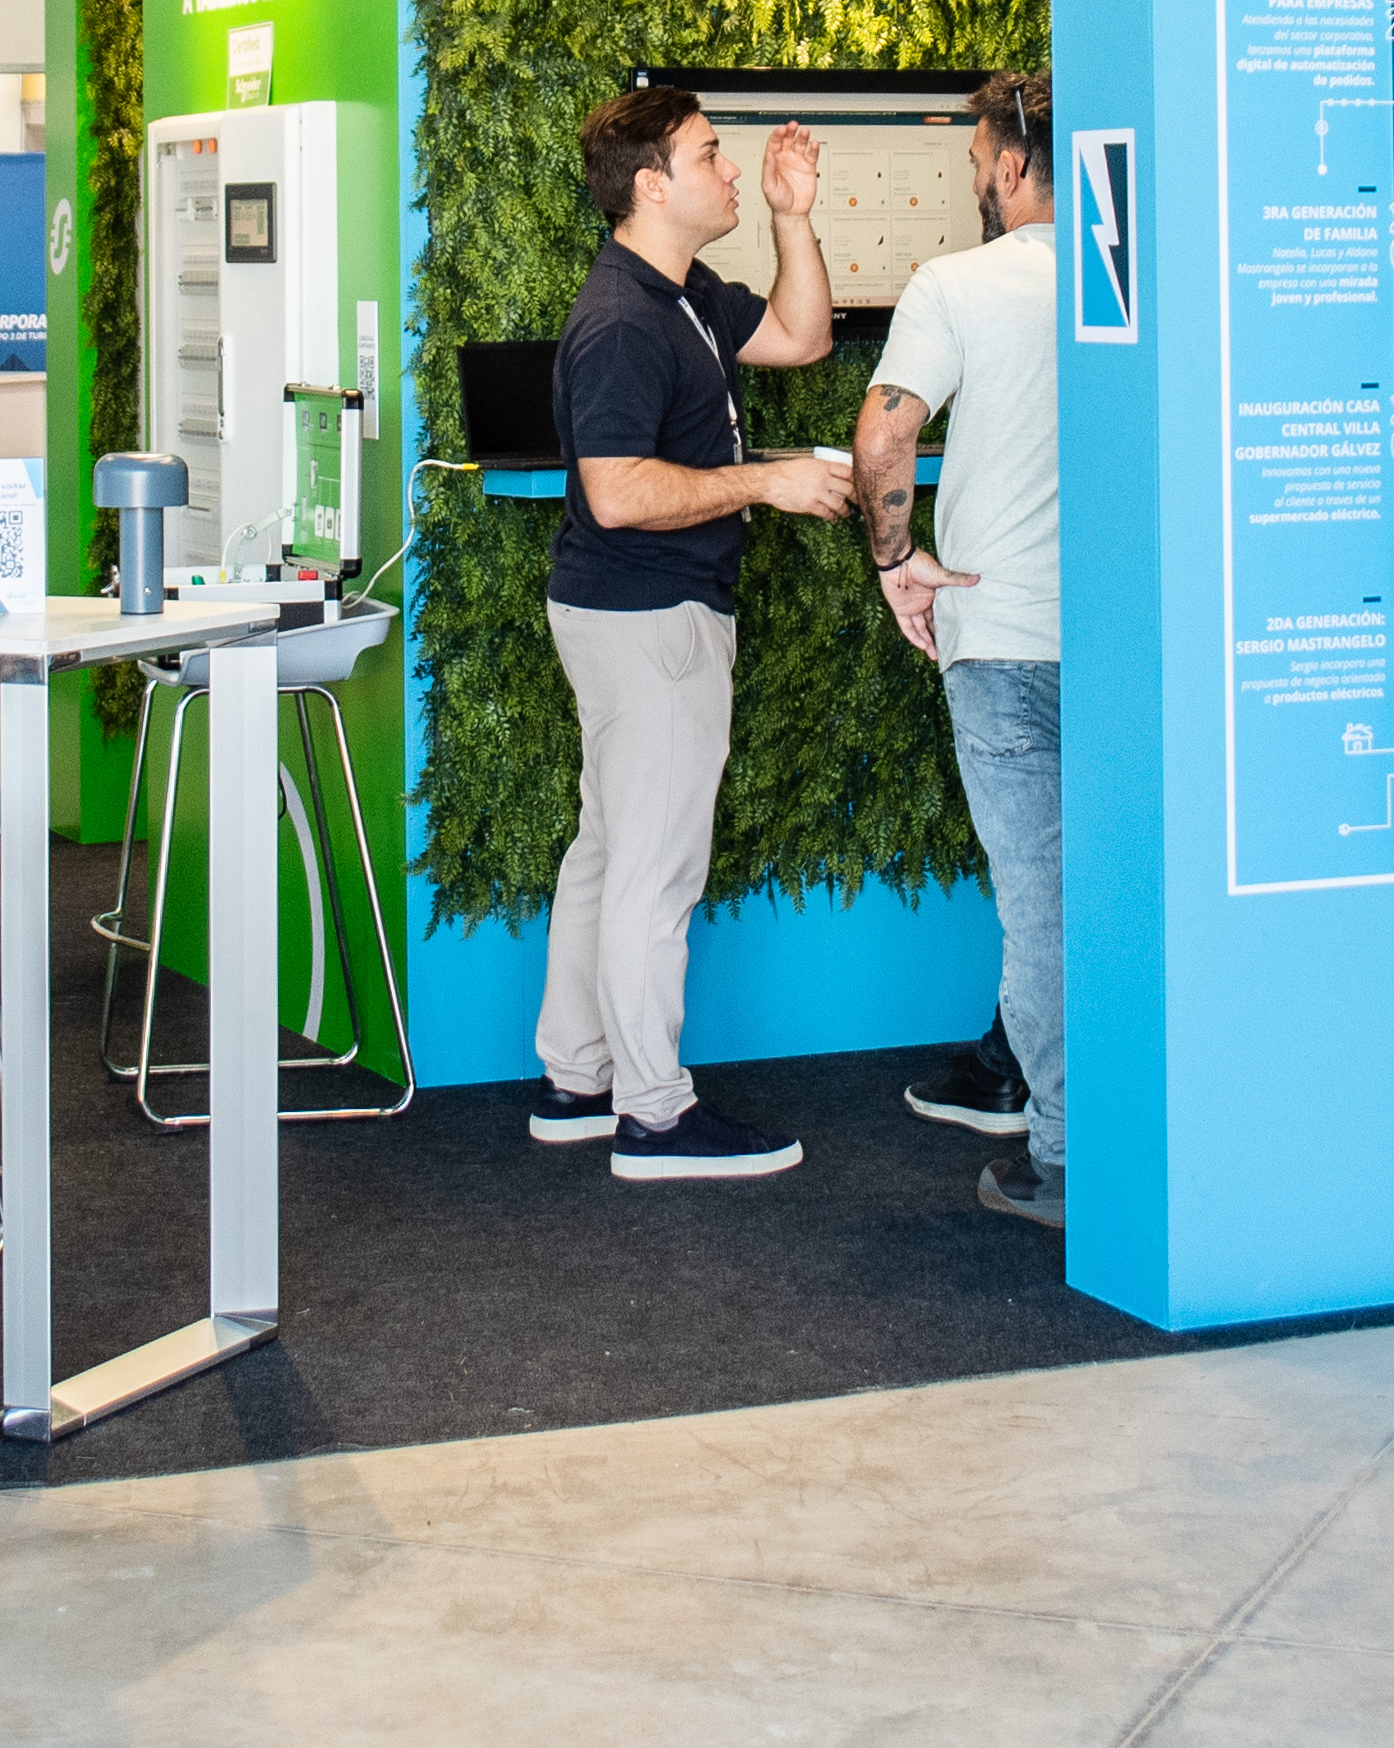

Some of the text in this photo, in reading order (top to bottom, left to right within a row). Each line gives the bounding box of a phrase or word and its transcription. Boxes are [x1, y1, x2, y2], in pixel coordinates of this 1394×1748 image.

[1314, 44, 1375, 57] plataforma
[1237, 59, 1271, 73] digital
[1274, 59, 1287, 70] de
[1313, 75, 1327, 86] de
[1263, 203, 1377, 219] 3RA GENERACIÓN
[1304, 227, 1378, 240] DE FAMILIA
[1339, 277, 1378, 288] mirada
[16, 332, 26, 340] DE
[1238, 398, 1380, 416] INAUGURACIÓN CASA
[1282, 421, 1380, 437] CENTRAL VILLA
[1235, 442, 1381, 460] GOBERNADOR GÁLVEZ
[1249, 511, 1328, 525] supermercado
[1266, 610, 1386, 631] 2DA GENERACIÓN:
[1237, 634, 1386, 654] SERGIO MASTRANGELO
